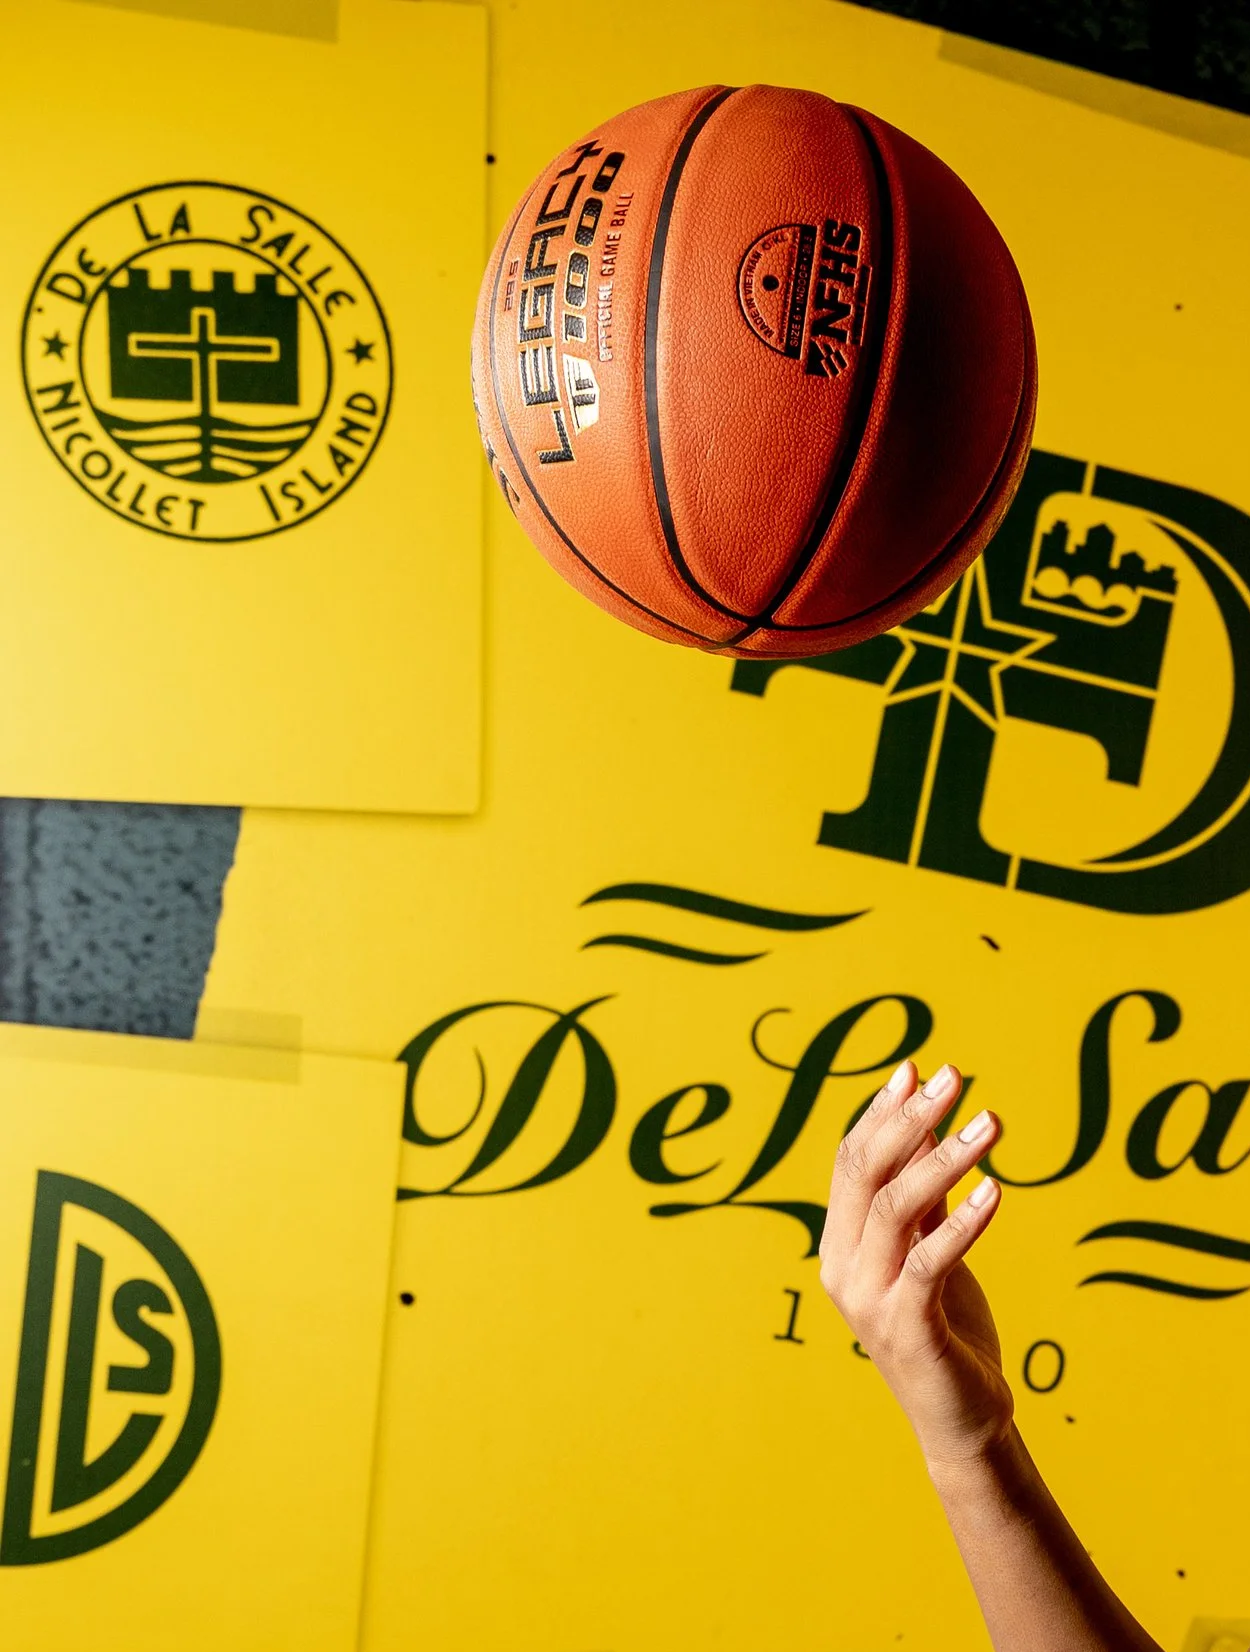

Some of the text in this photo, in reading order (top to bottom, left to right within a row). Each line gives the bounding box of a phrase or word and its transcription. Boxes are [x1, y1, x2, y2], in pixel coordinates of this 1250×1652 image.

[46, 202, 356, 317] DE LA SALLE
[562, 150, 626, 345] 1000
[601, 231, 621, 277] GAME
[610, 192, 635, 227] BALL
[519, 139, 605, 465] LEGACY
[744, 252, 763, 297] VIETNAM
[811, 218, 863, 343] NFHS
[36, 380, 206, 531] NICOLLET
[259, 391, 378, 523] ISLAND
